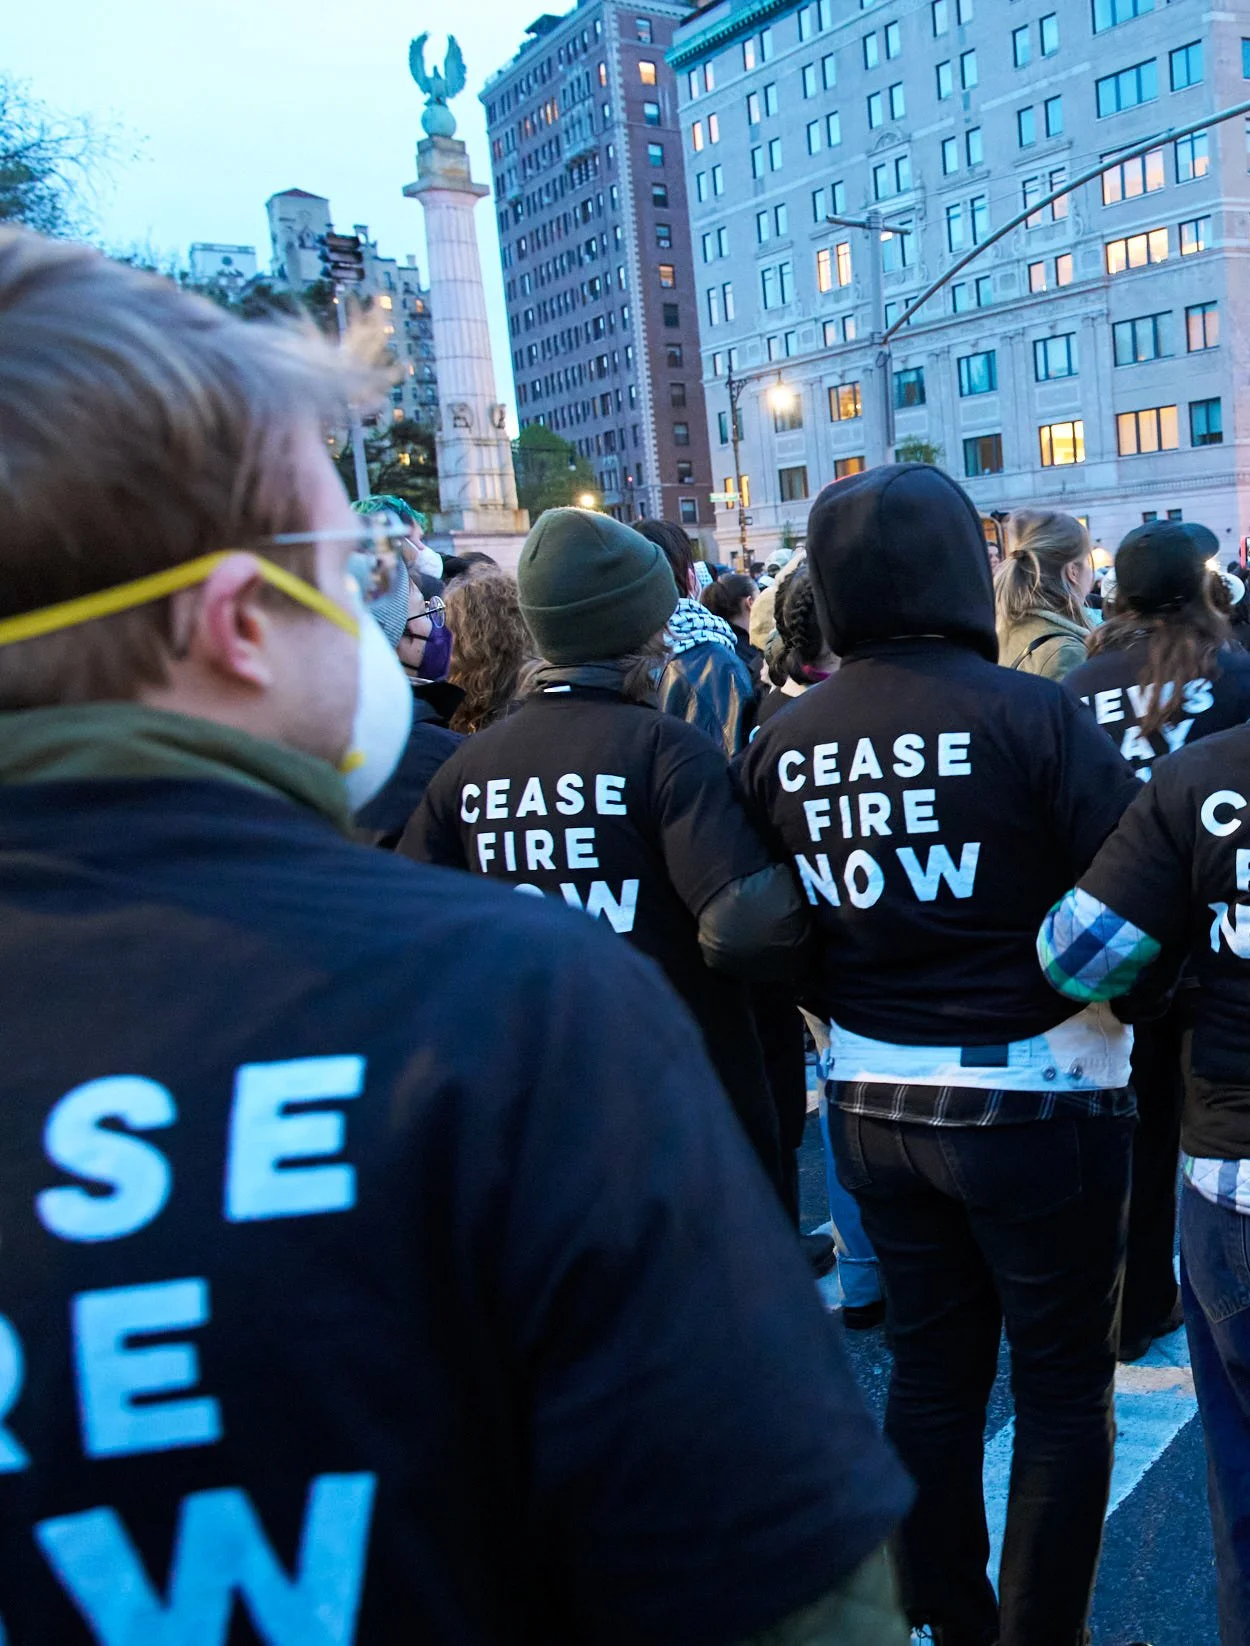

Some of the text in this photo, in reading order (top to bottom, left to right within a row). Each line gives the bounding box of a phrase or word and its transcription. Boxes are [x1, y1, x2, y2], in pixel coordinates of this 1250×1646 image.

[1079, 677, 1215, 725] EWS
[778, 732, 972, 793] CEASE
[1119, 718, 1196, 761] AY
[460, 773, 627, 824] CEASE
[803, 789, 940, 842] FIRE
[477, 827, 600, 873] FIRE
[795, 842, 981, 909] NOW
